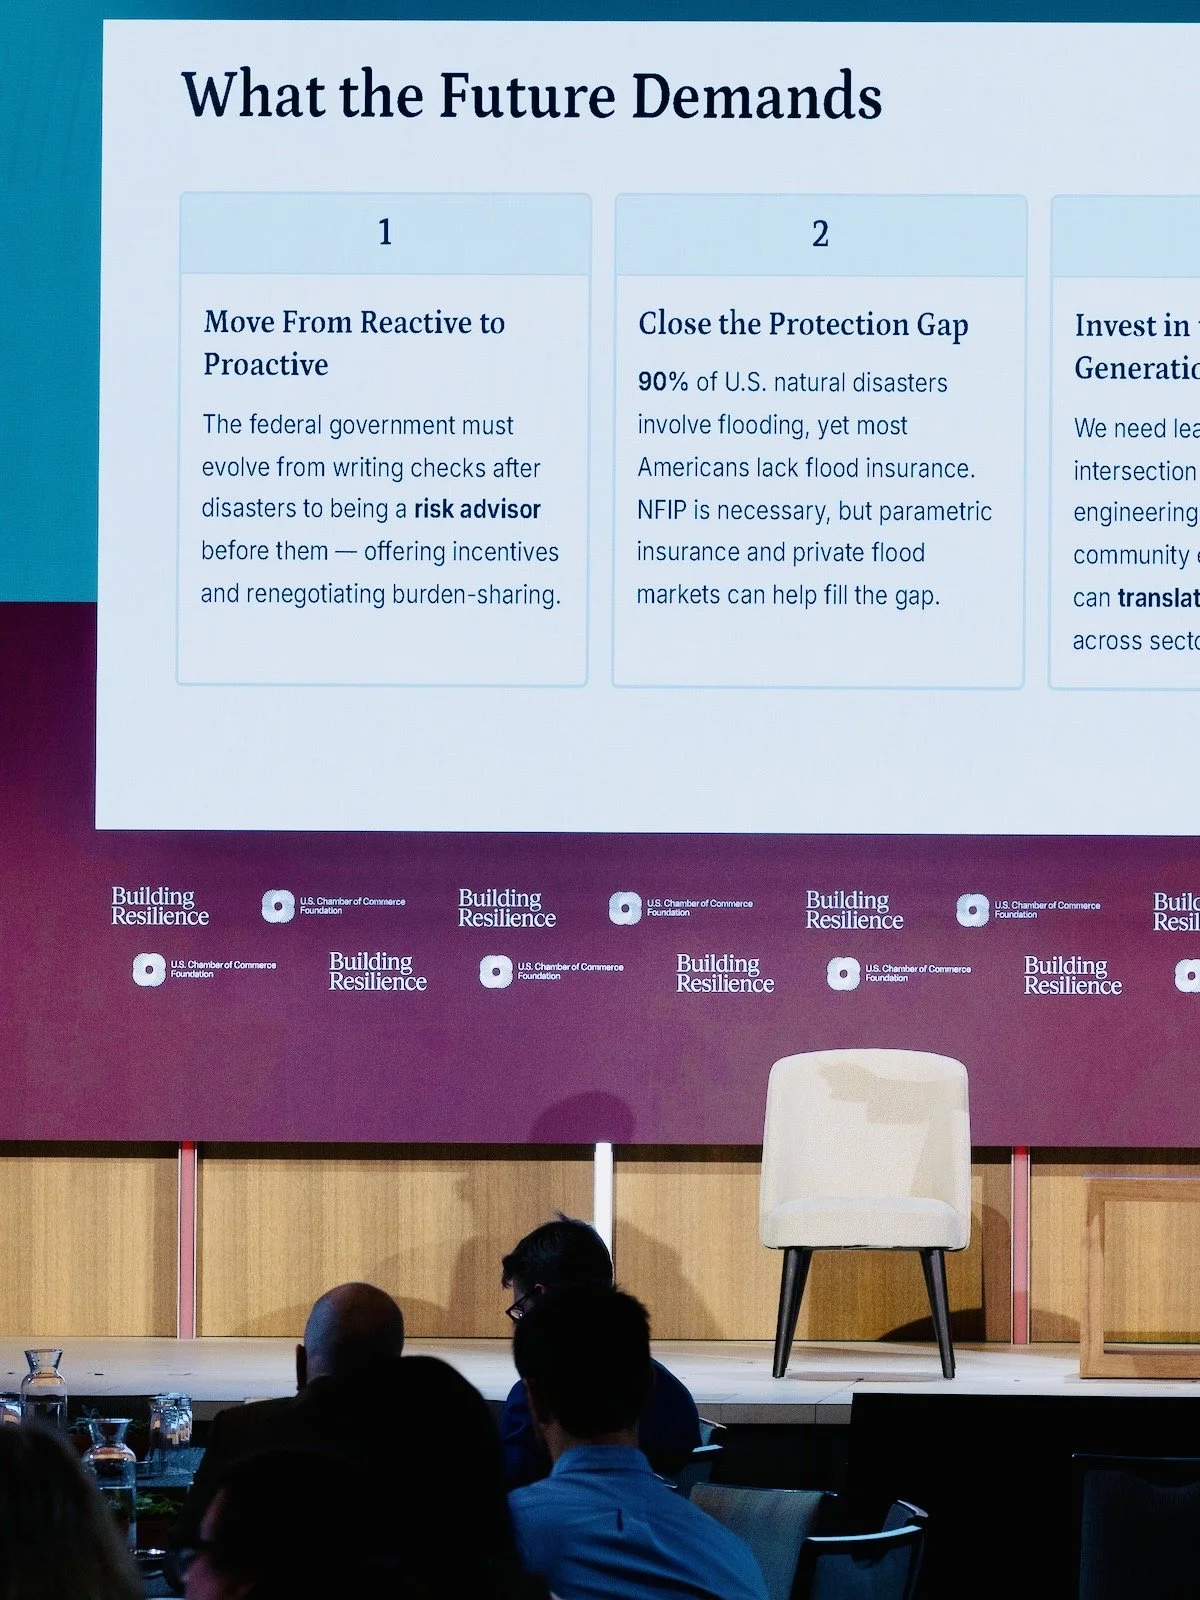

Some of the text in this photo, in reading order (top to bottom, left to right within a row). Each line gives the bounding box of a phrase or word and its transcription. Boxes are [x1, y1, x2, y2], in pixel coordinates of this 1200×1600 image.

[180, 65, 882, 120] What the Future Demands
[378, 217, 392, 246] 1
[812, 219, 829, 247] 2
[203, 308, 505, 335] Move From Reactive to
[639, 307, 969, 345] Close the Protection Gap
[1075, 313, 1158, 337] Invest
[1163, 312, 1191, 337] in
[203, 350, 329, 376] Proactive
[638, 370, 948, 393] 90% of U.S. natural disasters
[202, 412, 514, 440] The federal government must
[638, 412, 908, 441] involve flooding, yet most
[1074, 417, 1107, 438] We
[1114, 417, 1166, 439] need
[202, 455, 541, 483] evolve from writing checks after
[637, 456, 975, 479] Americans lack flood insurance.
[1074, 459, 1197, 481] intersection
[201, 496, 542, 524] disasters to being a risk advisor
[638, 498, 992, 526] NFIP is necessary, but parametric
[202, 539, 269, 561] before
[275, 540, 328, 561] them
[364, 539, 445, 567] offering
[453, 540, 559, 562] incentives
[637, 540, 925, 567] insurance and private flood
[1073, 543, 1190, 570] community
[201, 582, 561, 610] and renegotiating burden-sharing.
[637, 583, 940, 611] markets can help fill the gap.
[1073, 591, 1110, 608] can
[1073, 634, 1143, 651] across
[112, 886, 195, 910] Building
[299, 896, 406, 907] U.S. Chamber of Commerce
[459, 888, 542, 912] Building
[806, 890, 889, 914] Building
[994, 900, 1101, 911] U.S. Chamber of Commerce
[111, 906, 210, 926] Resilience
[300, 906, 343, 915] Foundation
[458, 908, 557, 928] Resilience
[805, 910, 904, 930] Resilience
[995, 910, 1038, 919] Foundation
[170, 959, 277, 970] U.S. Chamber of Commerce
[171, 969, 214, 978] Foundation
[330, 951, 413, 975] Building
[677, 953, 760, 977] Building
[865, 963, 972, 974] U.S. Chamber of Commerce
[1025, 955, 1108, 979] Building
[329, 971, 428, 991] Resilience
[676, 973, 775, 993] Resilience
[866, 973, 909, 982] Foundation
[1024, 975, 1123, 995] Resilience
